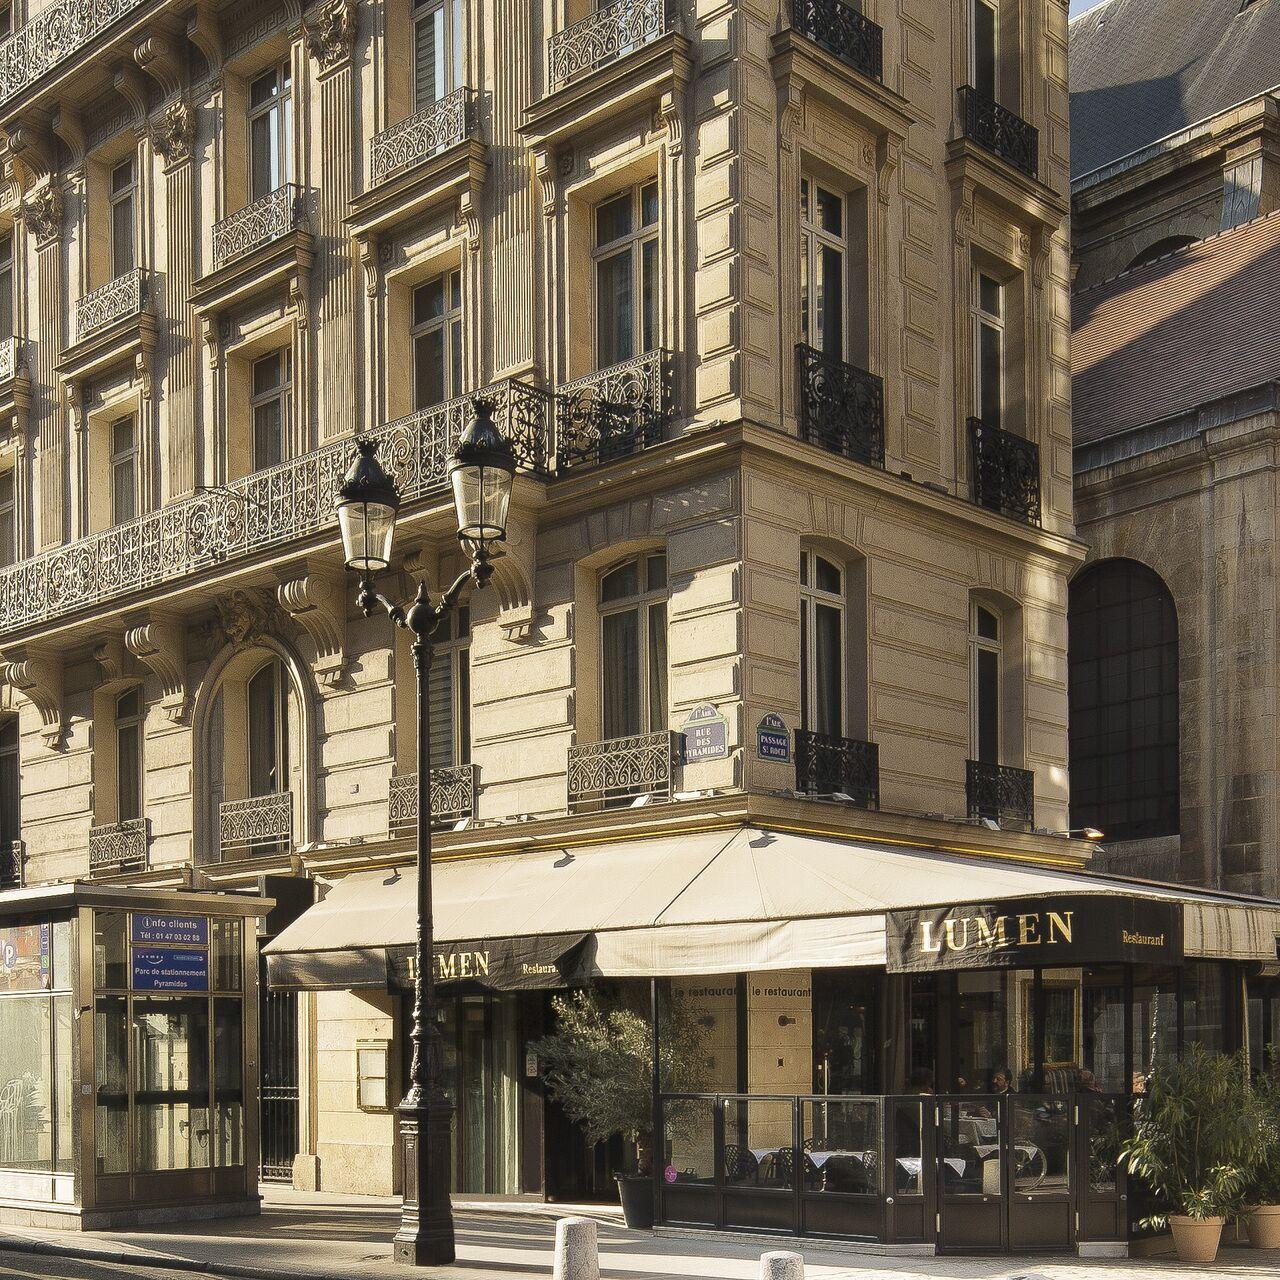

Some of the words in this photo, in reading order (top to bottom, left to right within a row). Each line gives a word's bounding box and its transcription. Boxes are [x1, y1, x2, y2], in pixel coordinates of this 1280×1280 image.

[695, 727, 711, 738] RUE
[696, 737, 711, 747] DES
[760, 735, 787, 746] PASSAGE
[168, 920, 197, 929] clients
[155, 932, 163, 940] 01
[920, 911, 1074, 953] LUMEN
[1122, 929, 1164, 946] Restaurant
[406, 950, 490, 980] LMEN
[522, 962, 559, 974] Restaura
[135, 967, 151, 975] Parc
[160, 968, 206, 977] stationnement
[153, 979, 188, 988] Pyramides
[688, 986, 736, 997] restaura
[751, 985, 761, 996] le
[764, 986, 811, 998] restaurant
